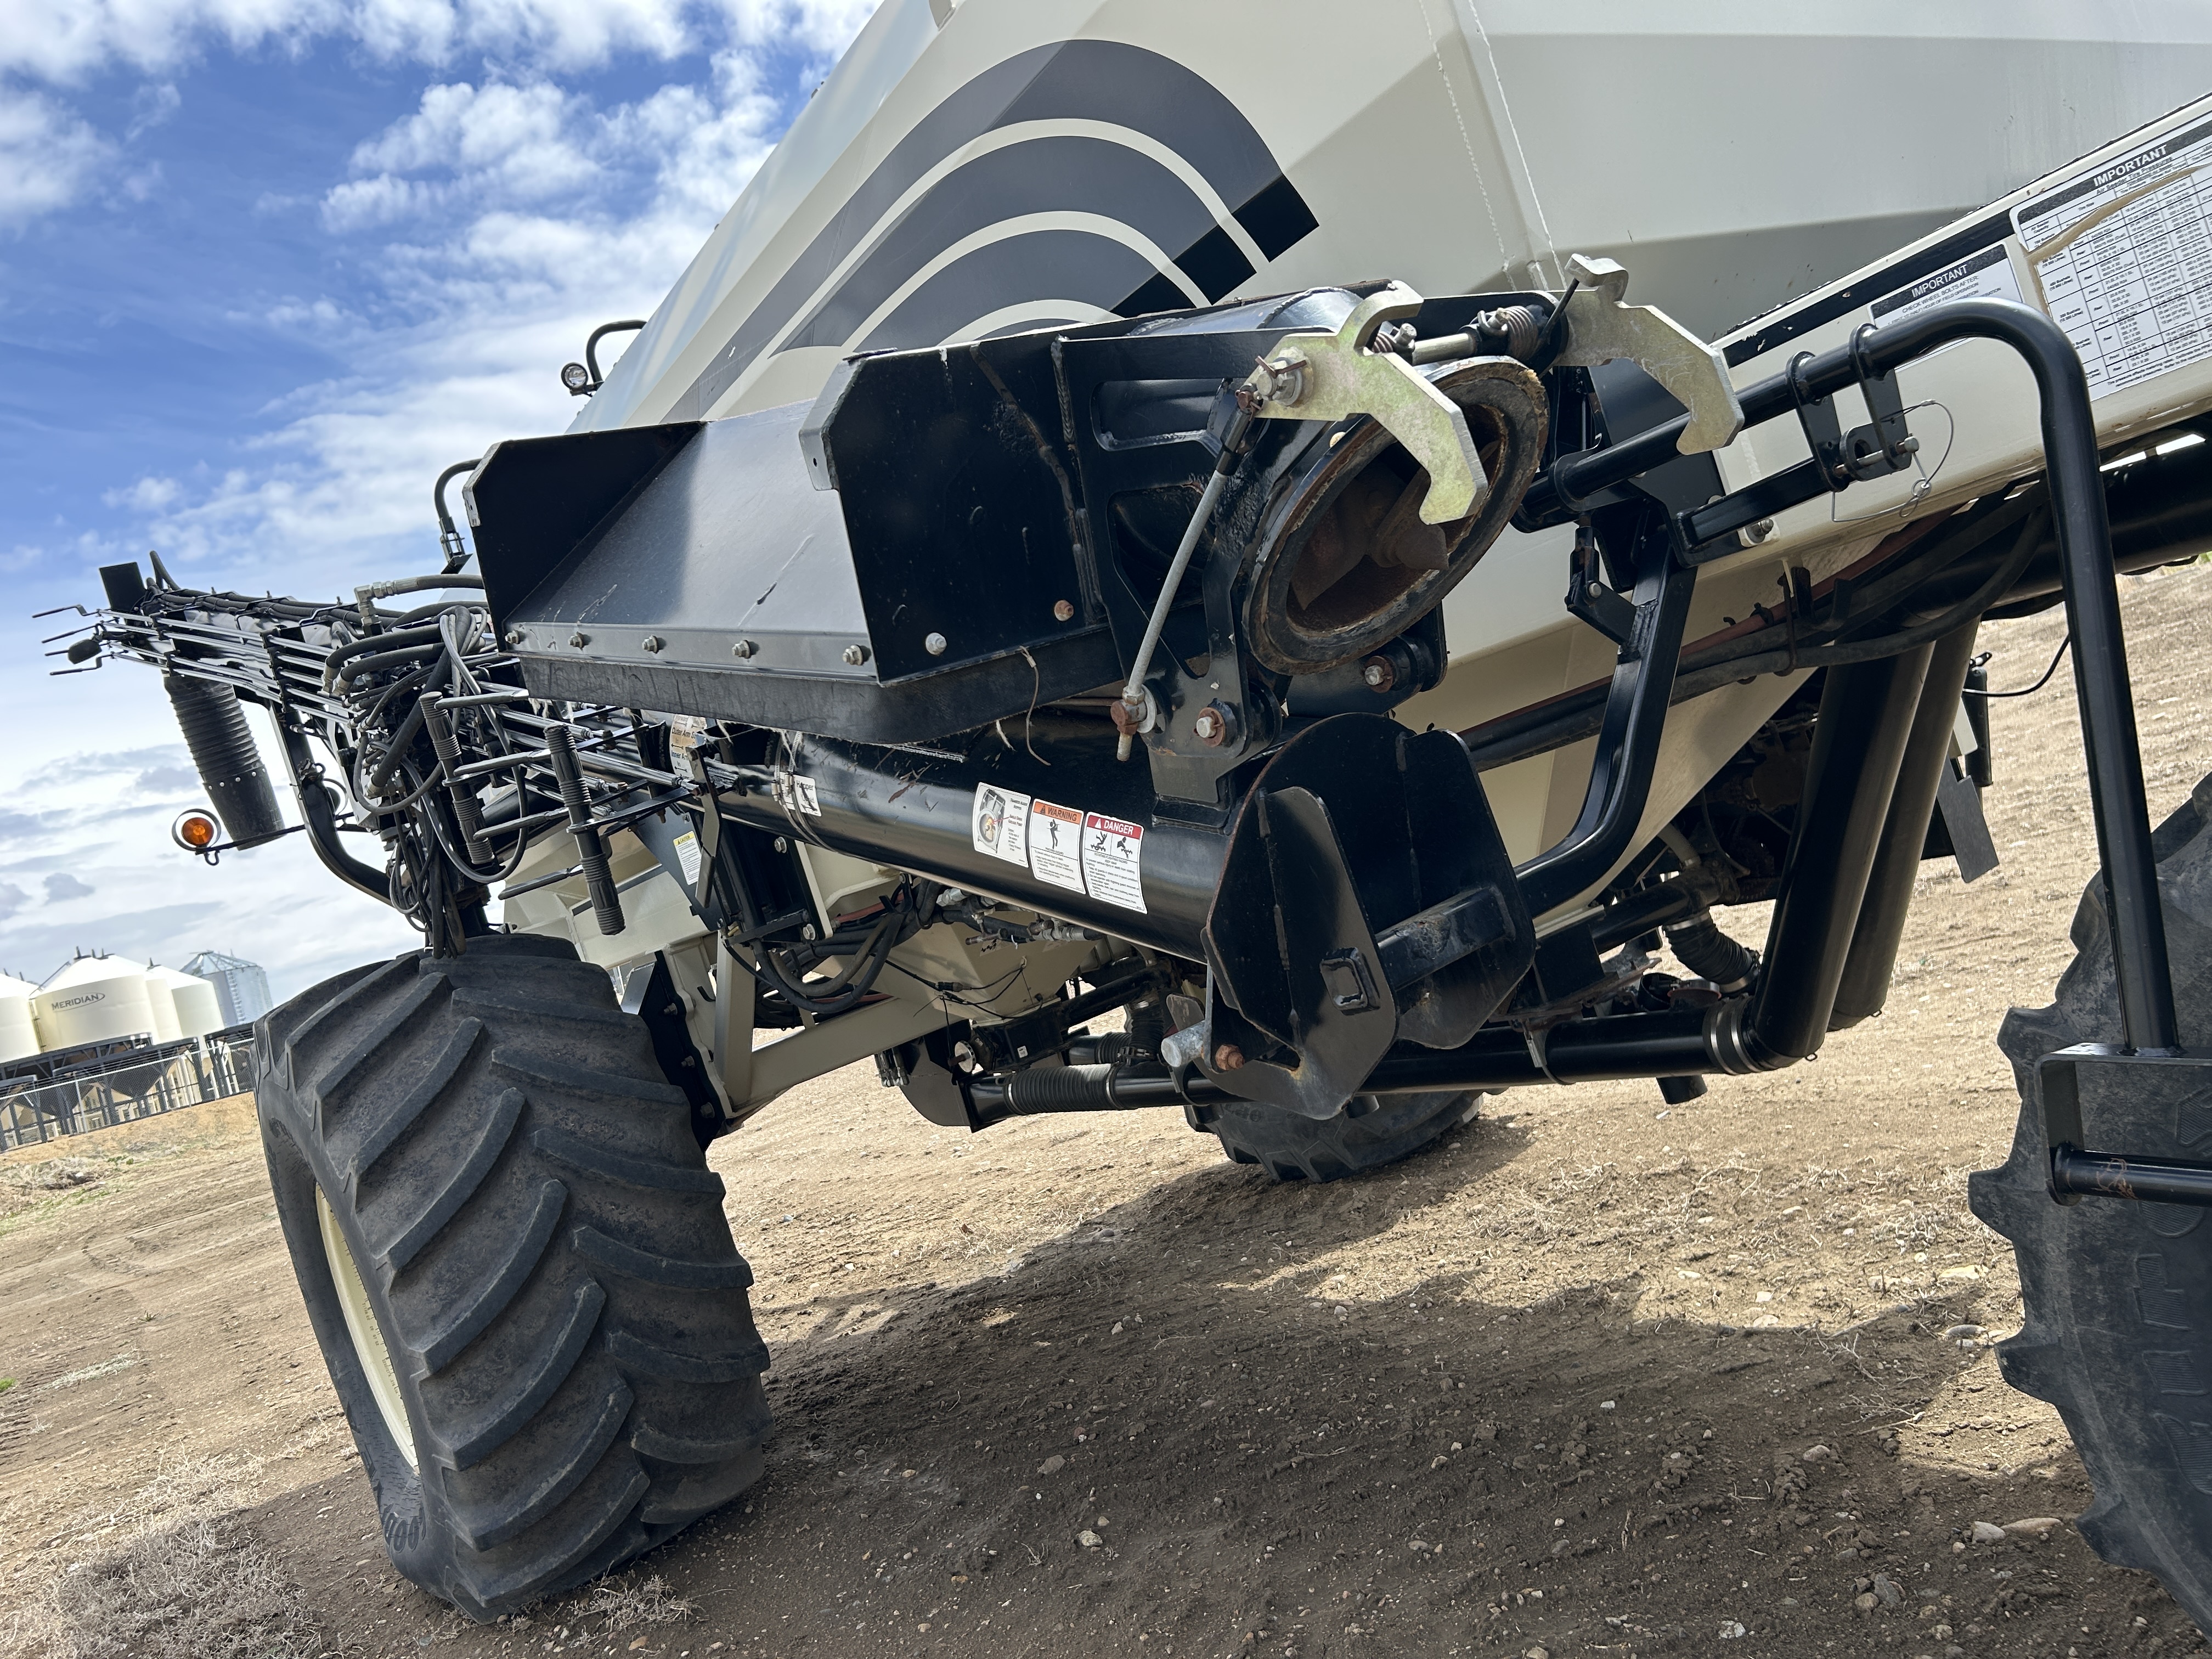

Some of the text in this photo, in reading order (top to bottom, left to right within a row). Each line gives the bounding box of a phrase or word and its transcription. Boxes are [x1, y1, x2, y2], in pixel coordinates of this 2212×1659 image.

[2094, 144, 2167, 187] IMPORTANT
[1911, 264, 1968, 298] IMPORTANT
[1902, 301, 1920, 313] CHECK
[1922, 292, 1939, 304] WHEEL
[1941, 284, 1959, 296] BOLTS
[1923, 301, 1935, 310] HOUR
[1943, 293, 1954, 301] FIELD
[1955, 282, 1978, 296] OPERATION
[672, 727, 683, 736] Outer
[682, 730, 691, 738] Arm
[1047, 806, 1077, 822] WARNING
[1103, 819, 1134, 836] DANGER
[52, 992, 99, 1011] MERIDIAN
